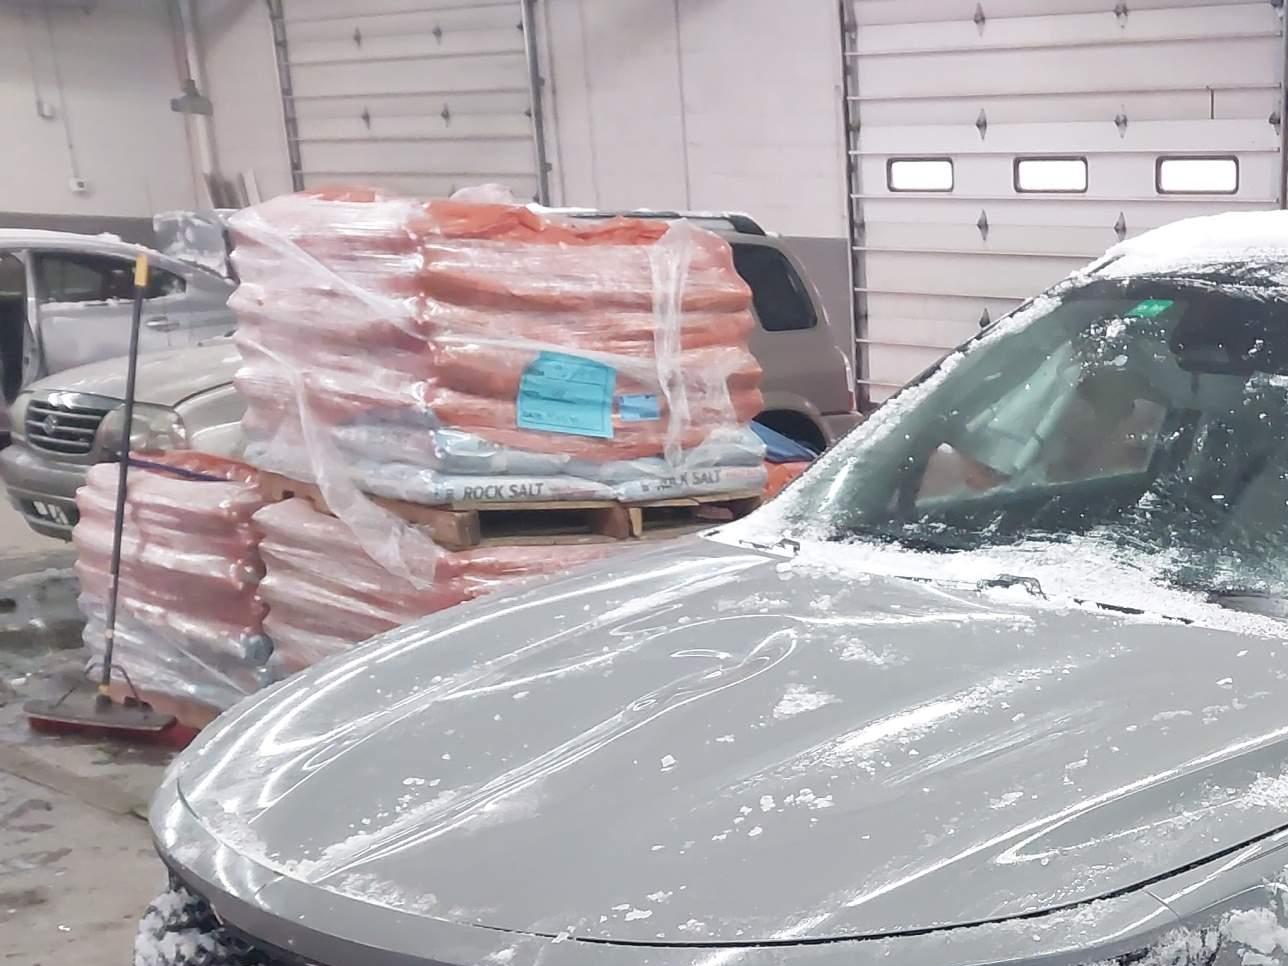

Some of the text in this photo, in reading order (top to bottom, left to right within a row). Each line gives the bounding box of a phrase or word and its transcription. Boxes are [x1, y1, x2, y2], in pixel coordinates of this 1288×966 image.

[692, 469, 721, 485] SALT
[463, 485, 504, 500] ROCK
[508, 482, 544, 498] SALT
